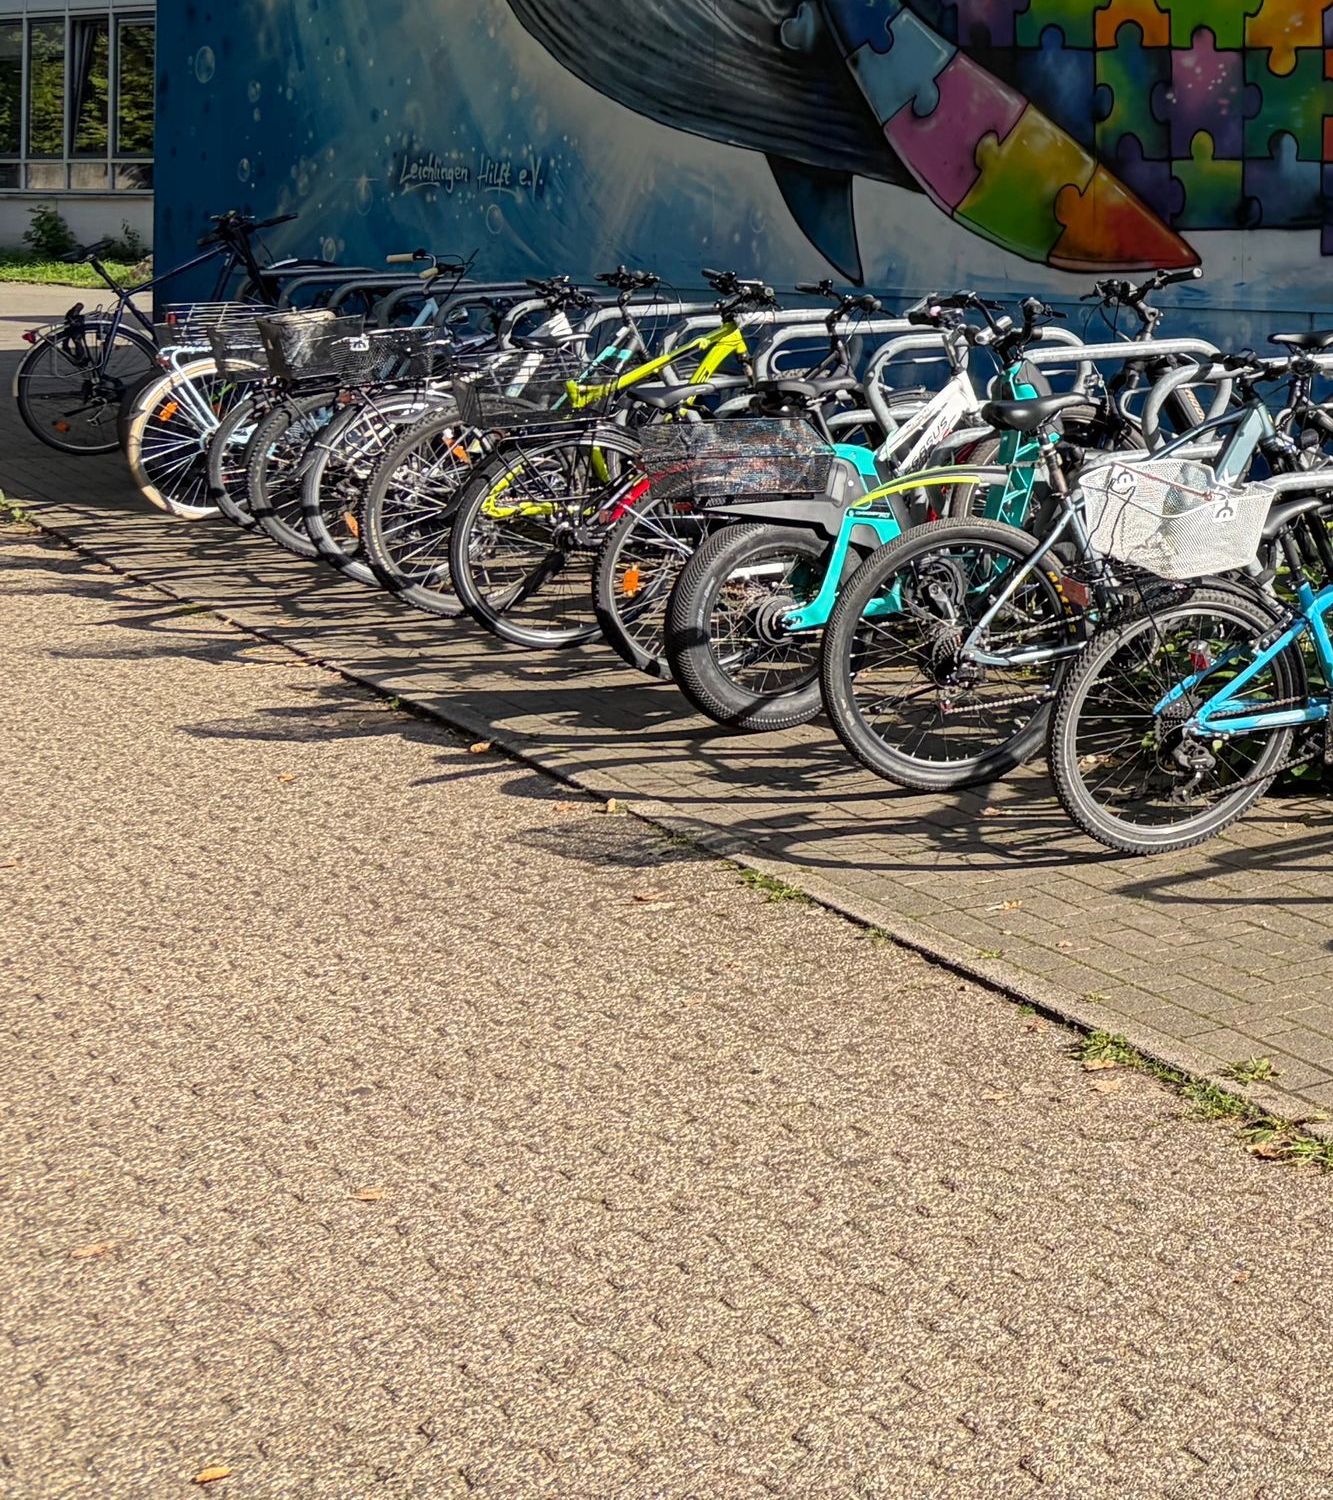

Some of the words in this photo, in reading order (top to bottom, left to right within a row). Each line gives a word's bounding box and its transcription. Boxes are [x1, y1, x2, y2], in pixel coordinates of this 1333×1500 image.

[400, 153, 468, 193] Leichlingen
[478, 153, 511, 192] Hilft
[1046, 571, 1077, 633] MAXXS
